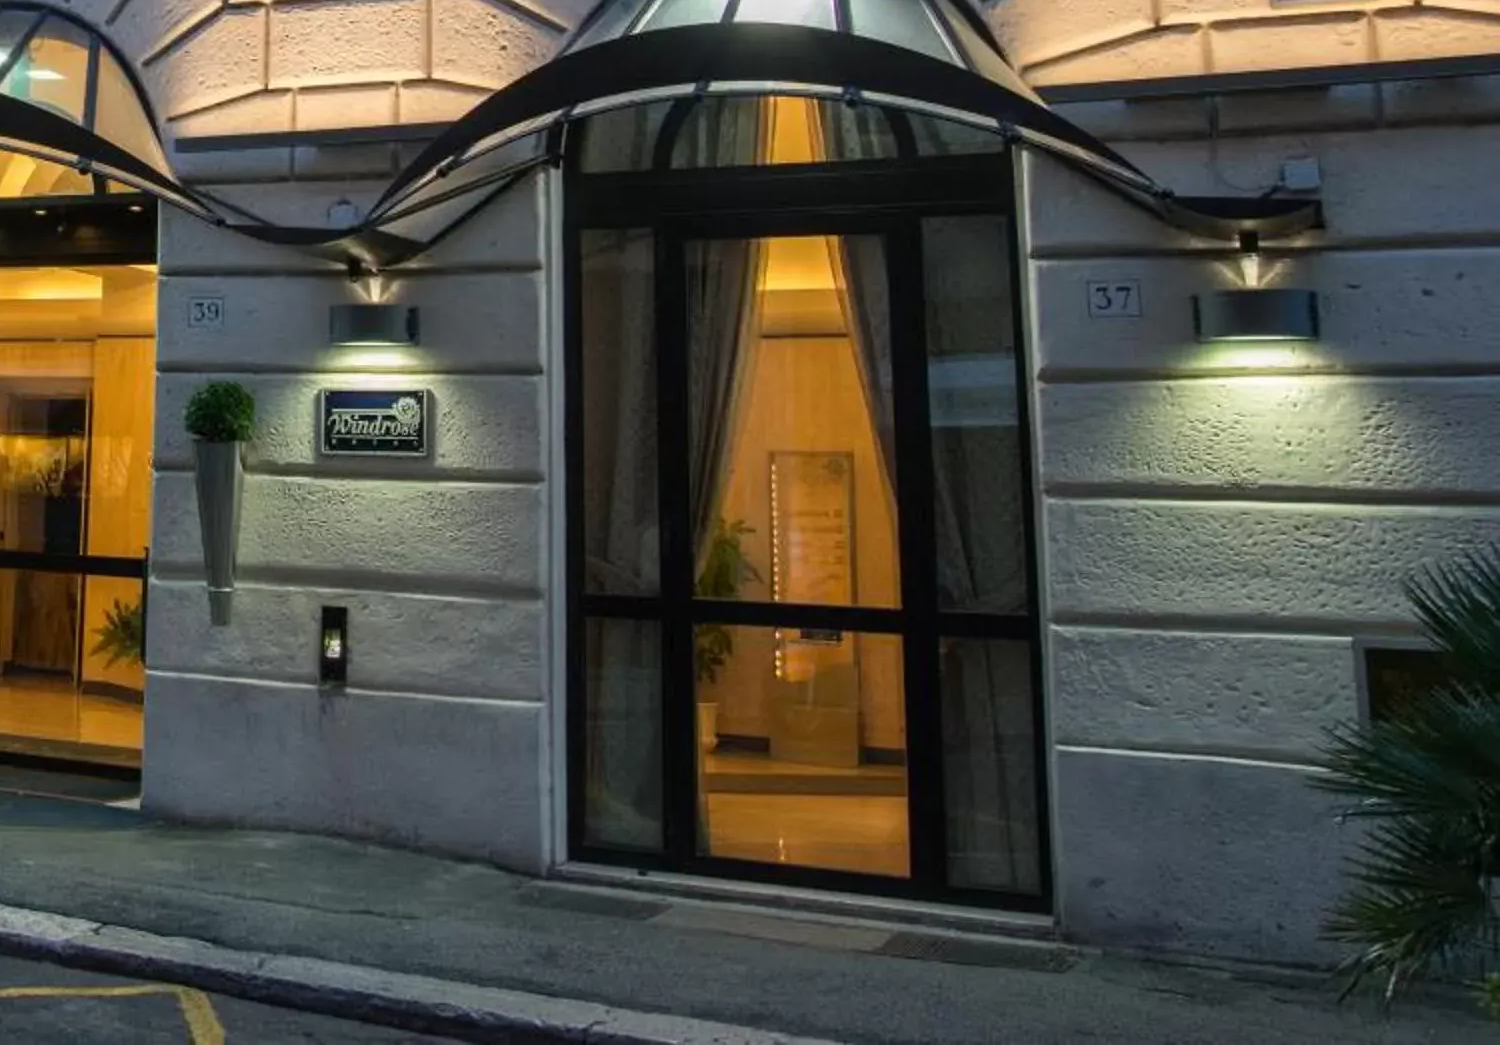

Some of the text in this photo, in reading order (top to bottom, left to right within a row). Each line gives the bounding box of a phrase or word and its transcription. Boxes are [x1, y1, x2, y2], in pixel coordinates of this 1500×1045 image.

[1095, 286, 1132, 310] 37
[194, 302, 219, 322] 39
[327, 412, 420, 437] Windrose
